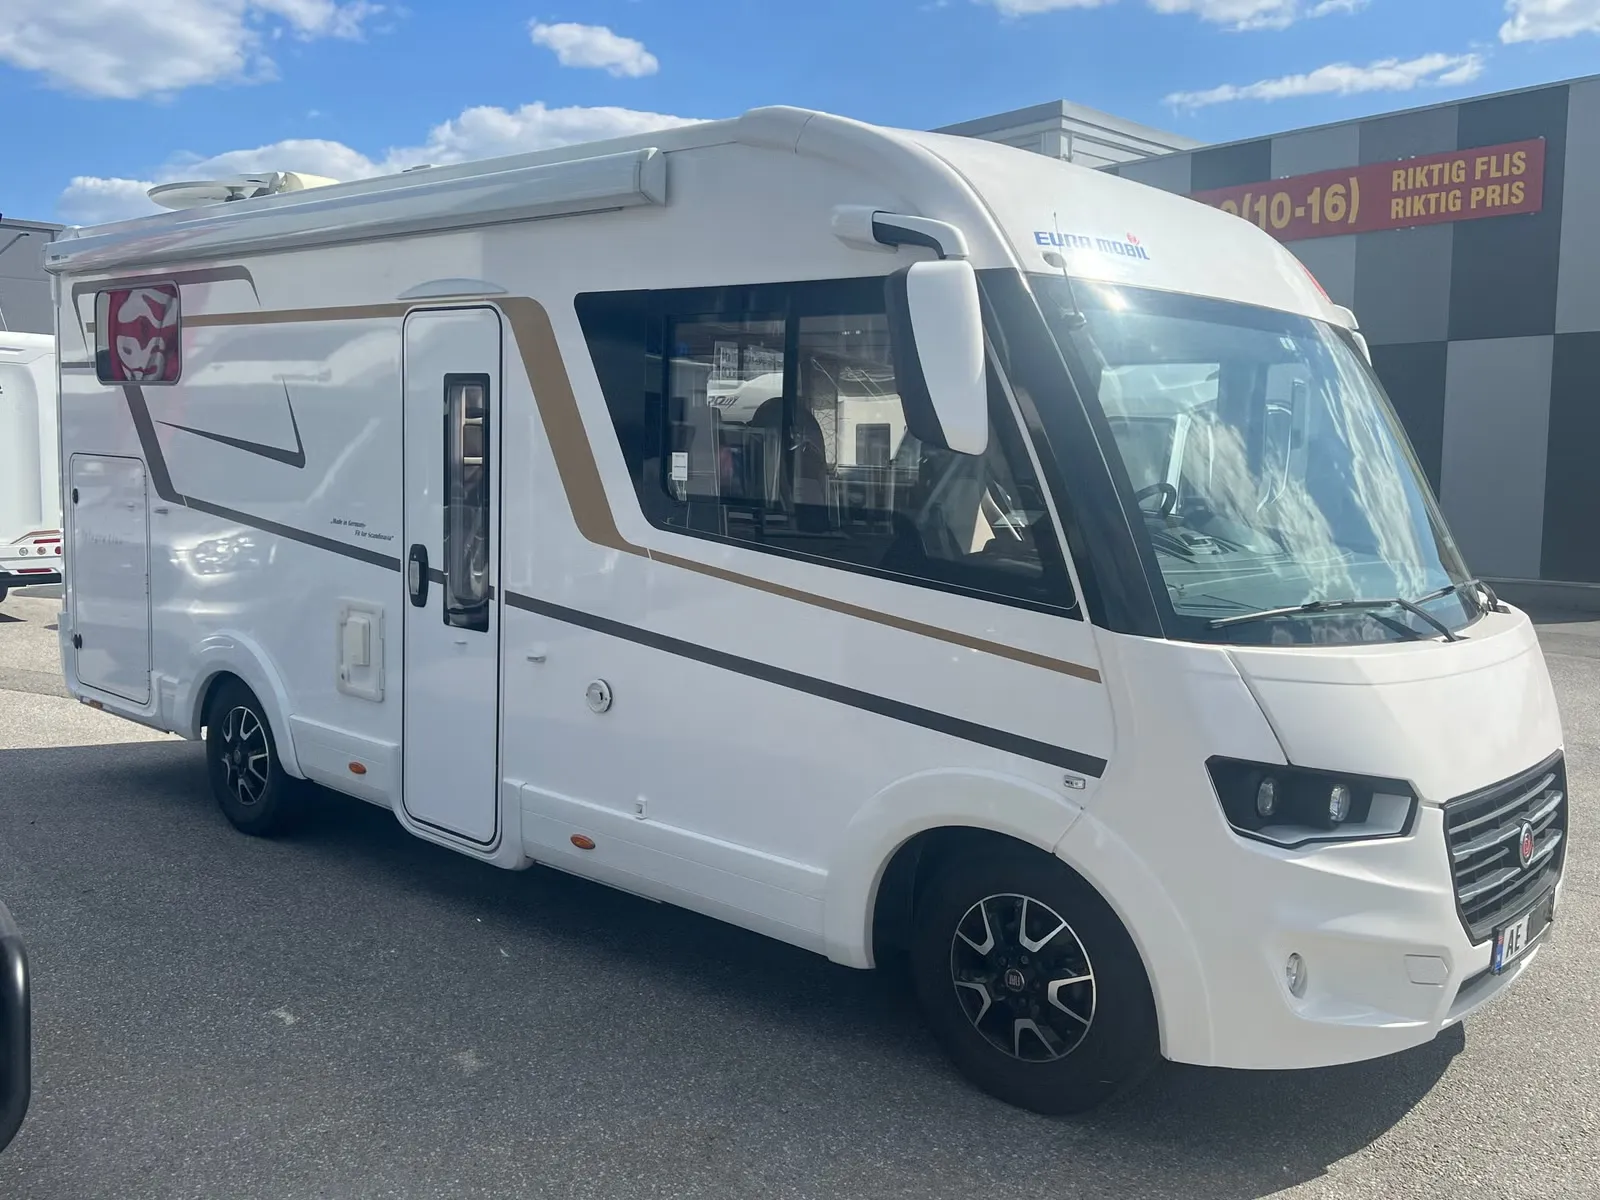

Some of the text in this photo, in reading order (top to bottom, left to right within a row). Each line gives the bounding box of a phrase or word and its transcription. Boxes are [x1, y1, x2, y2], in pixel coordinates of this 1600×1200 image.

[1392, 151, 1527, 193] RIKTIG FLIS
[1390, 181, 1526, 220] RIKTIG PRIS
[1096, 238, 1150, 260] MOBIL
[1505, 924, 1522, 958] AE
